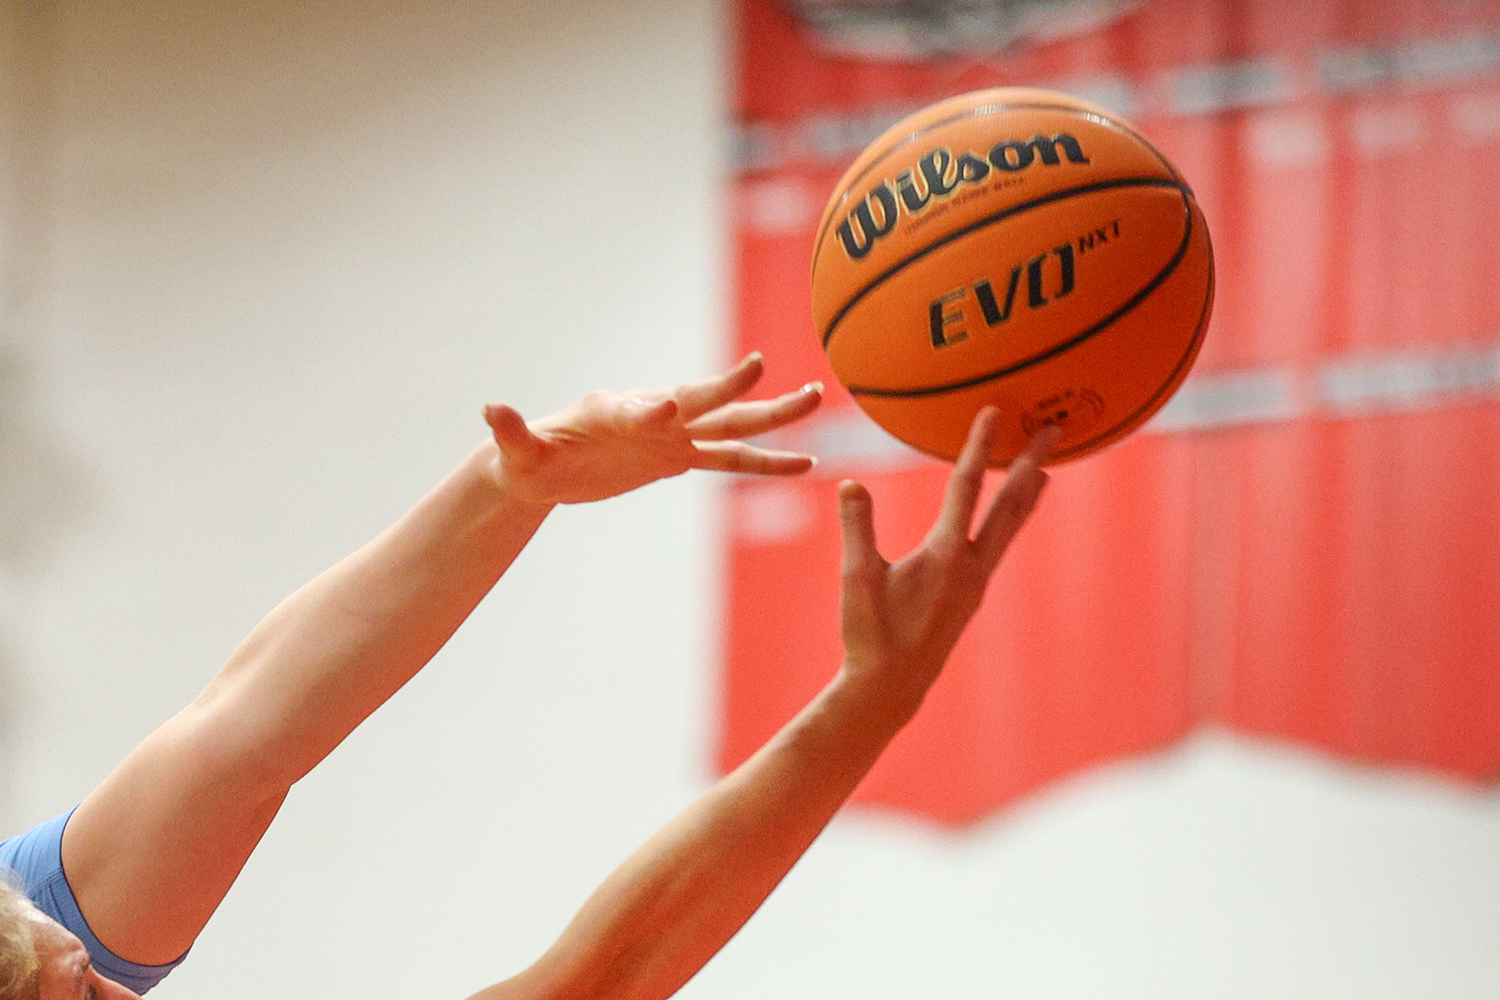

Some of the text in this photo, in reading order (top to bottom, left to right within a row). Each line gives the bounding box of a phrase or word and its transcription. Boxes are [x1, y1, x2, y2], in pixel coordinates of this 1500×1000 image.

[835, 133, 1090, 260] Wilson
[929, 219, 1121, 349] EVO NXT
